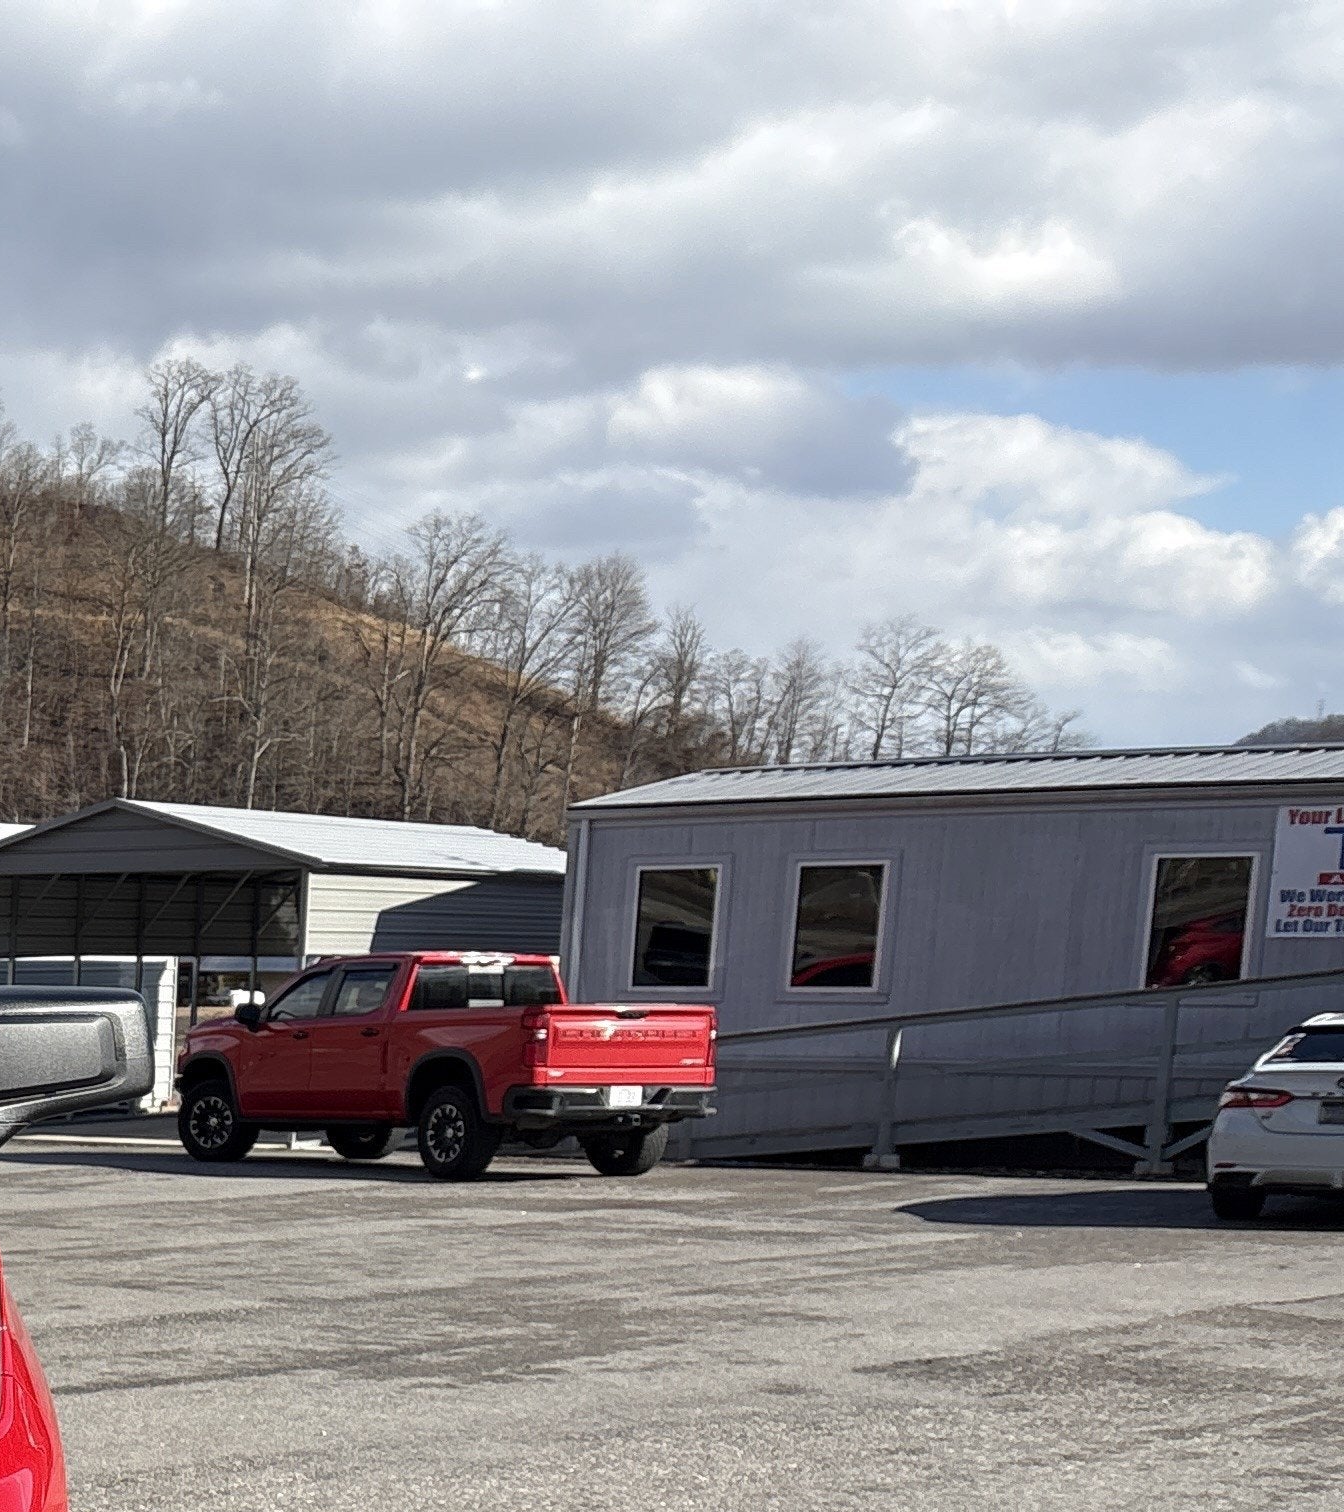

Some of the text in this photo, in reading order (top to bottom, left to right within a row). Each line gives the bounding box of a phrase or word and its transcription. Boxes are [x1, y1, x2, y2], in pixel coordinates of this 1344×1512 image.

[1288, 809, 1332, 825] Your
[1280, 889, 1306, 903] We
[1288, 904, 1324, 917] Zero
[1276, 919, 1298, 933] Let
[1303, 919, 1331, 933] Our
